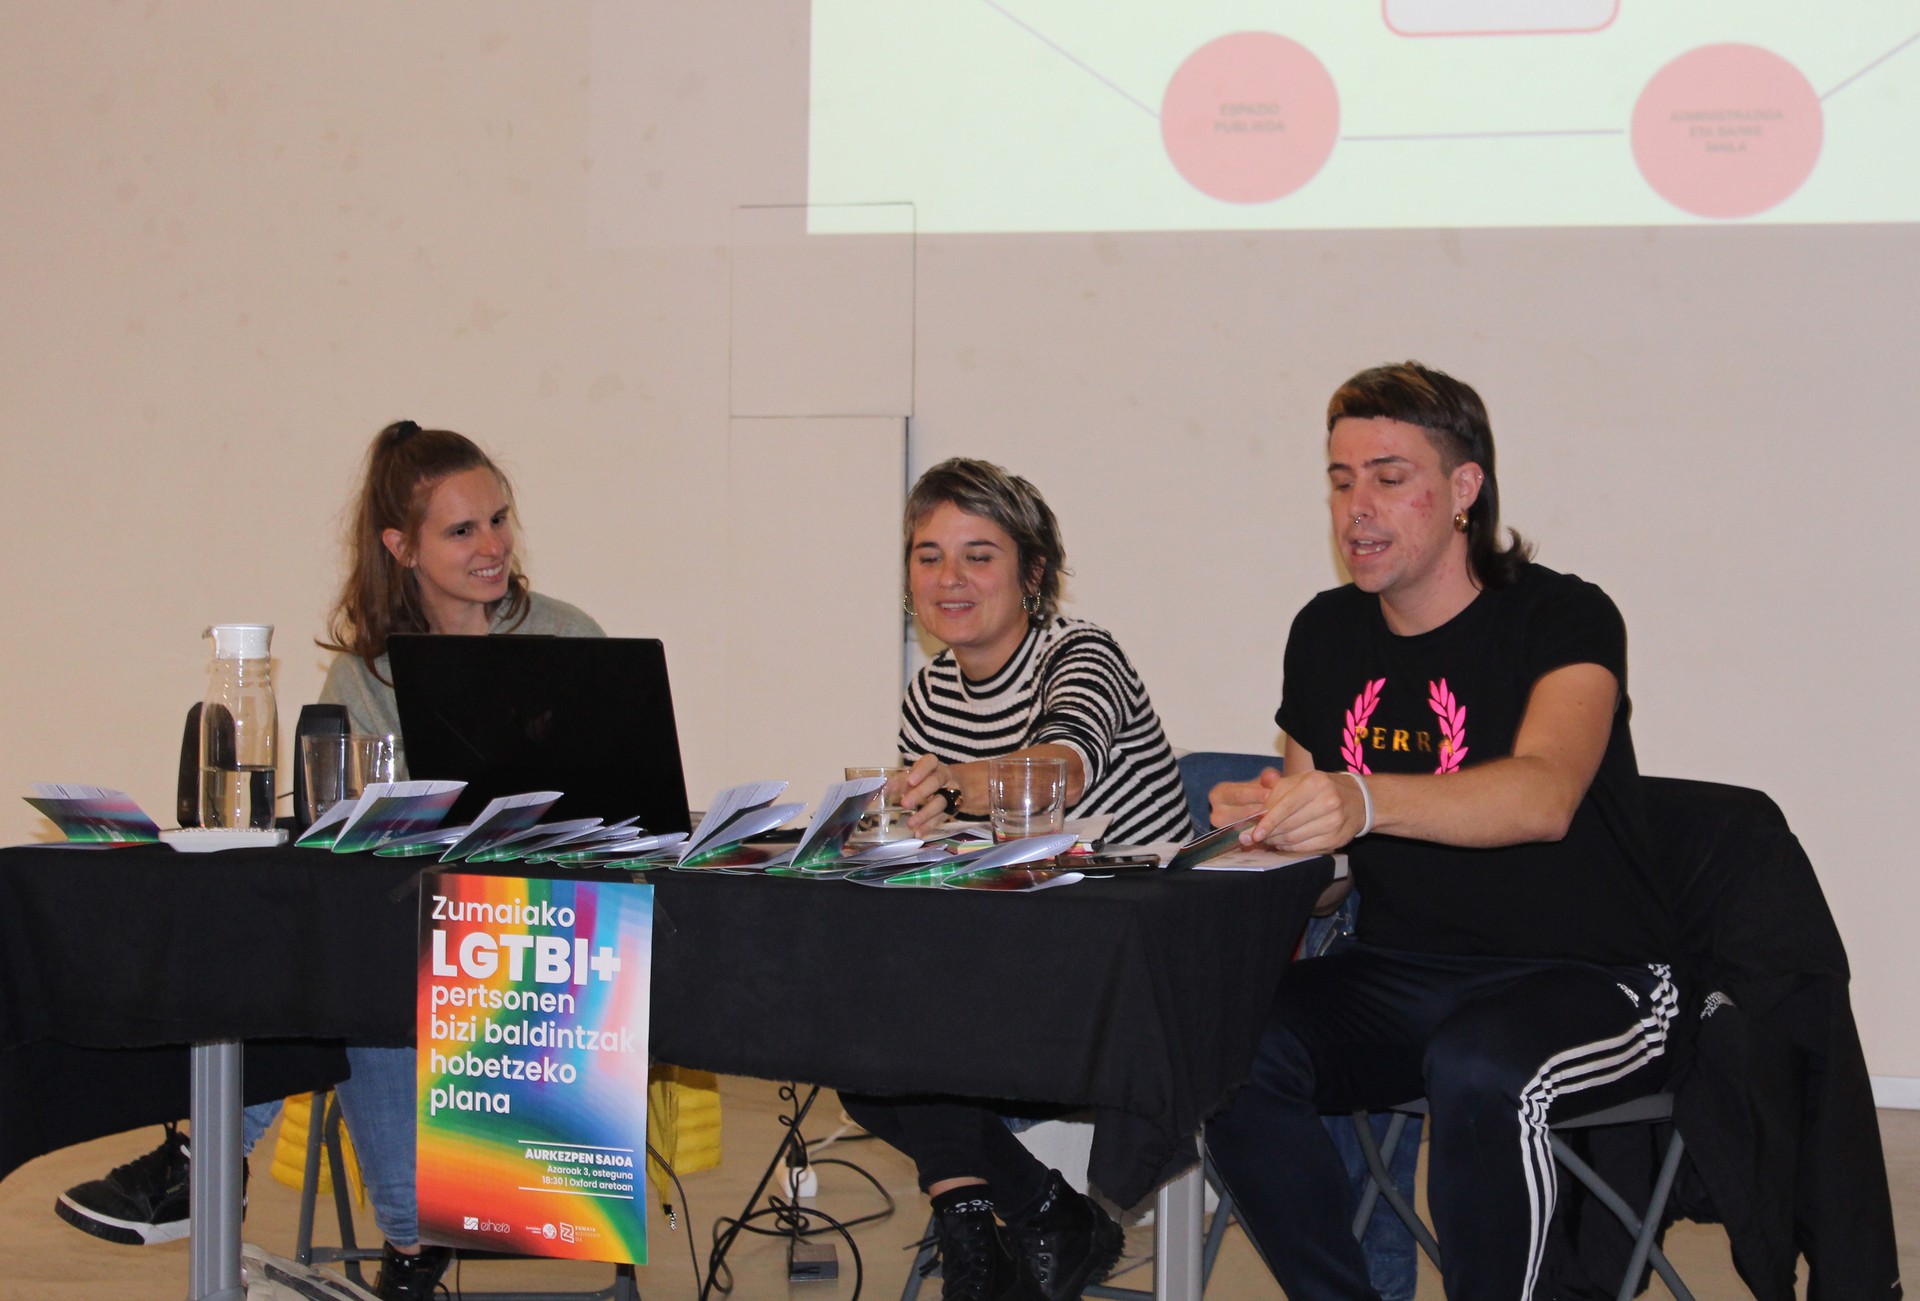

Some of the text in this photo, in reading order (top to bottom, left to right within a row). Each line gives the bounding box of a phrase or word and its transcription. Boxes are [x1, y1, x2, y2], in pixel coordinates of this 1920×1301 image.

[432, 895, 576, 928] Zumaiako
[432, 929, 621, 986] LGTBI+
[431, 984, 575, 1014] pertsonen
[431, 1014, 635, 1053] bizi baldintzak
[430, 1048, 577, 1084] hobetzeko
[430, 1084, 511, 1117] plana
[525, 1148, 634, 1168] AURKEZPEN SAIOA
[547, 1165, 634, 1181] Azaroak 3, osteguna
[542, 1175, 563, 1185] 18:30
[569, 1179, 598, 1189] Oxford
[599, 1182, 634, 1192] aretoan
